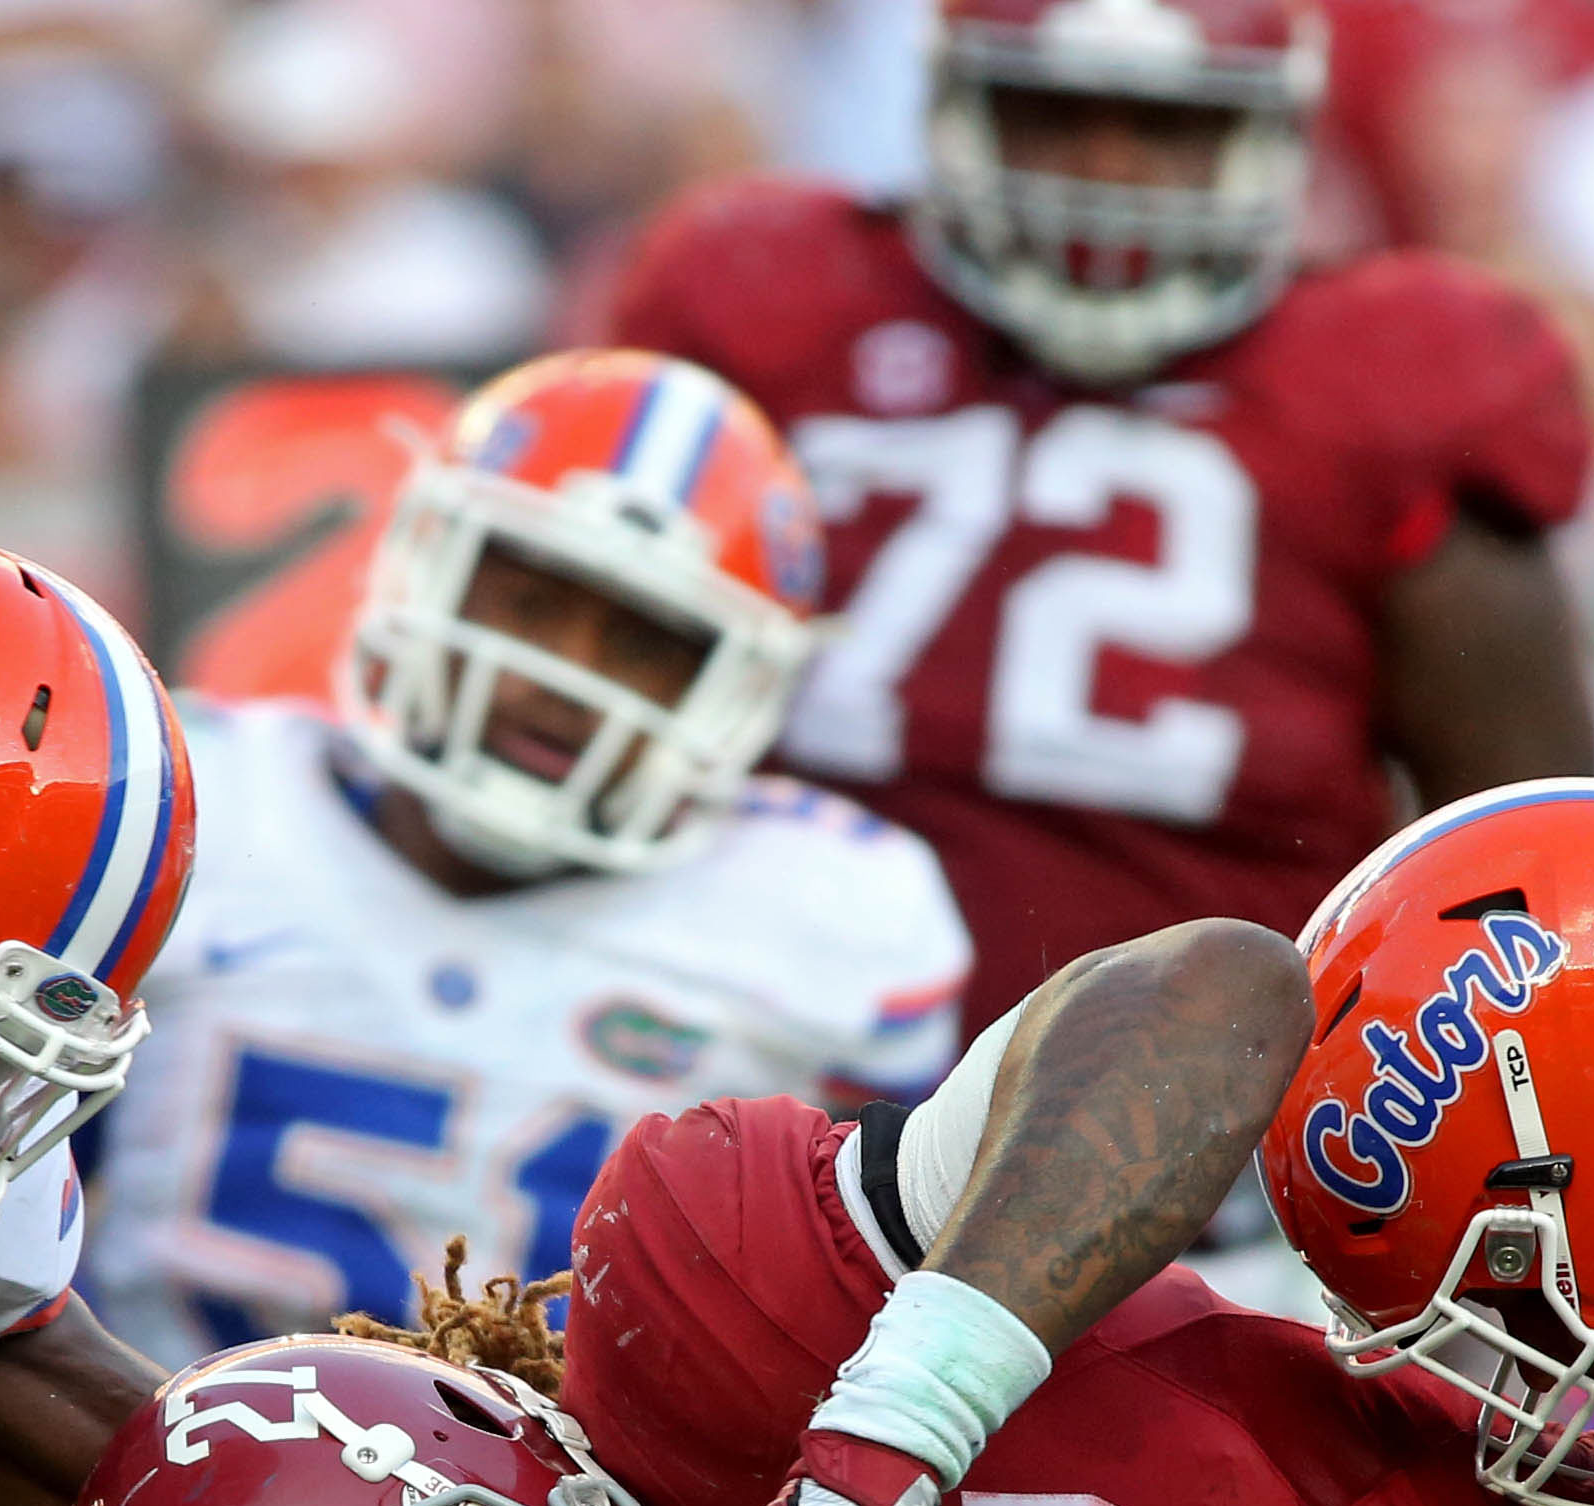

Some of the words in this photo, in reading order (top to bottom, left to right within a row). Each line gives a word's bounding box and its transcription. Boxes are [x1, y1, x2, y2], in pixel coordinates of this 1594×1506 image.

[778, 402, 1258, 824] 72
[168, 1028, 624, 1350] 51
[1303, 911, 1570, 1214] Gators
[1507, 1046, 1529, 1091] TCP
